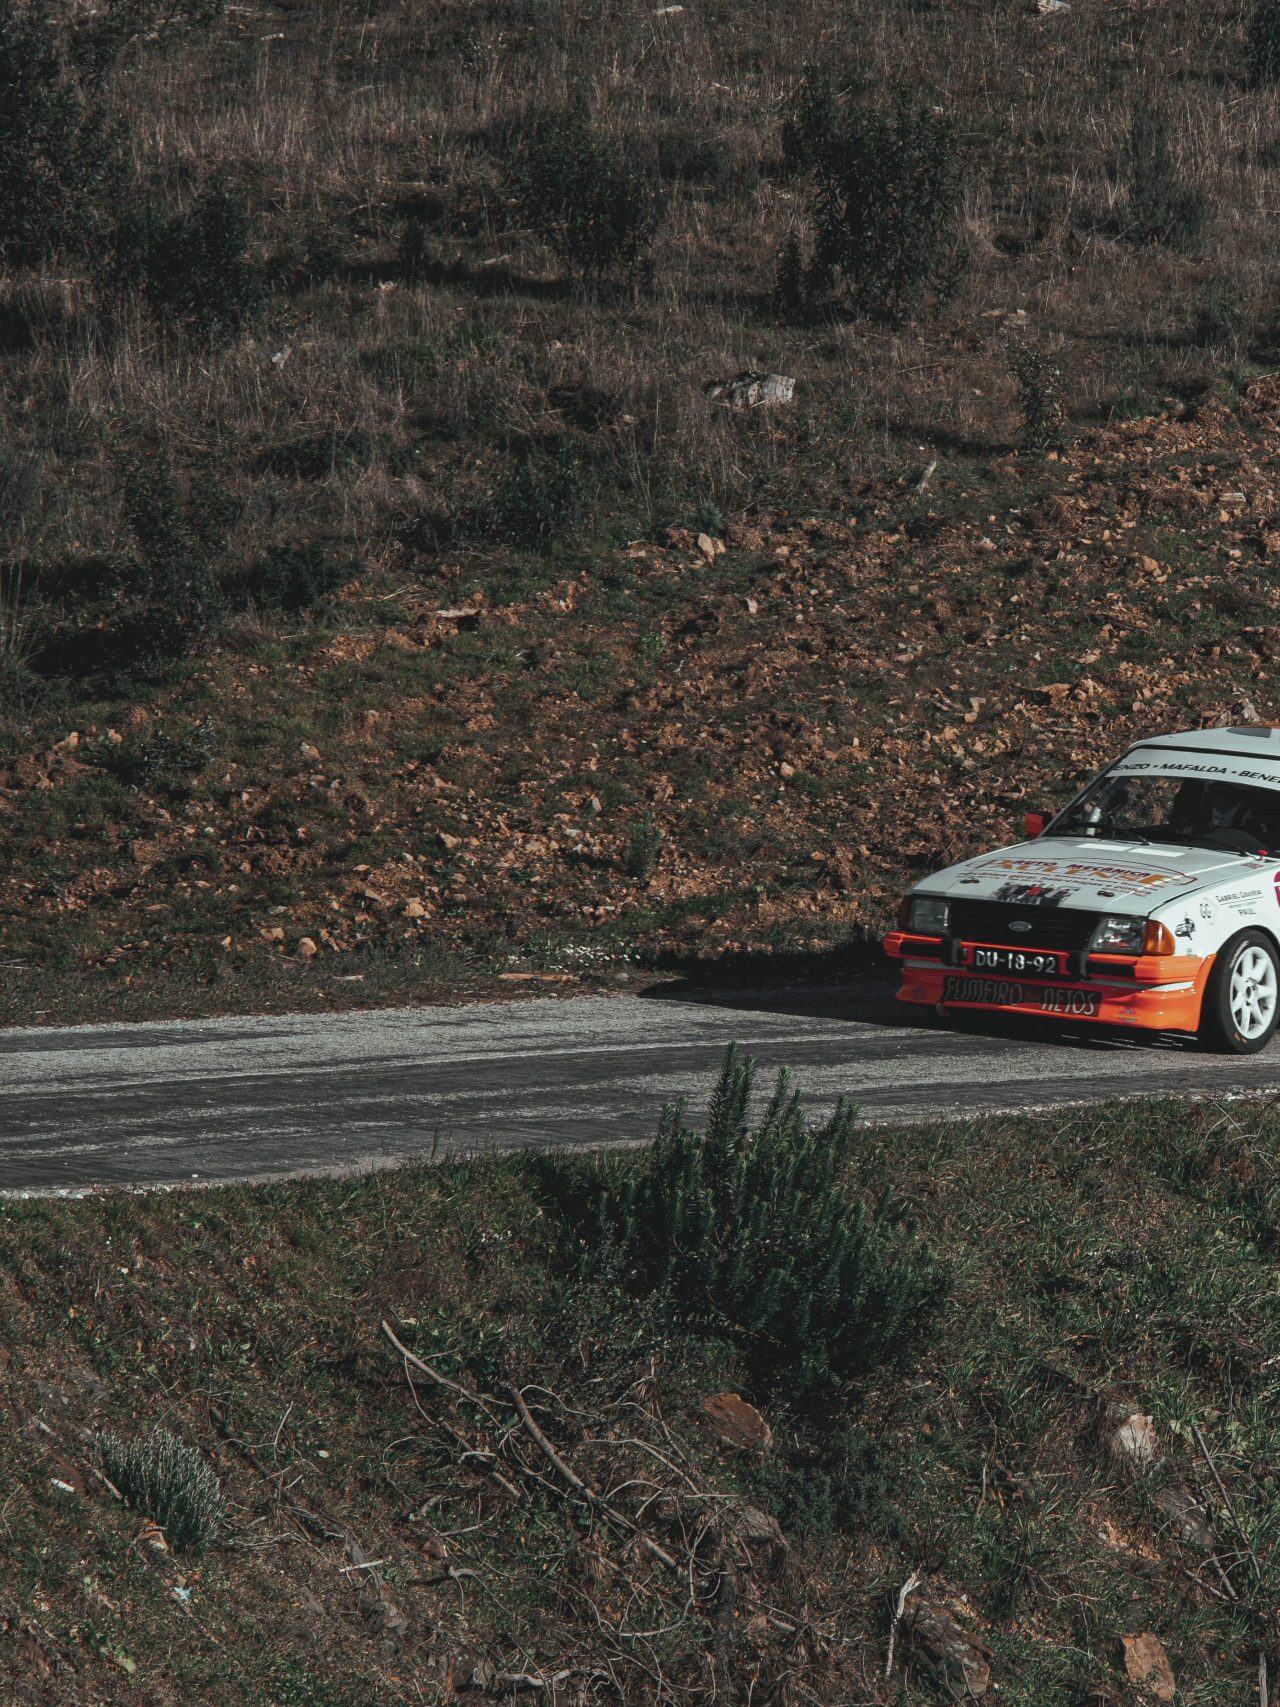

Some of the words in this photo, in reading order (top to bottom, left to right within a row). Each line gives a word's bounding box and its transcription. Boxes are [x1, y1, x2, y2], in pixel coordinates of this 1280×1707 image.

[1159, 763, 1226, 775] MAFALDA
[976, 950, 1057, 974] DU-18-92
[944, 976, 1022, 1006] FUMEIRO
